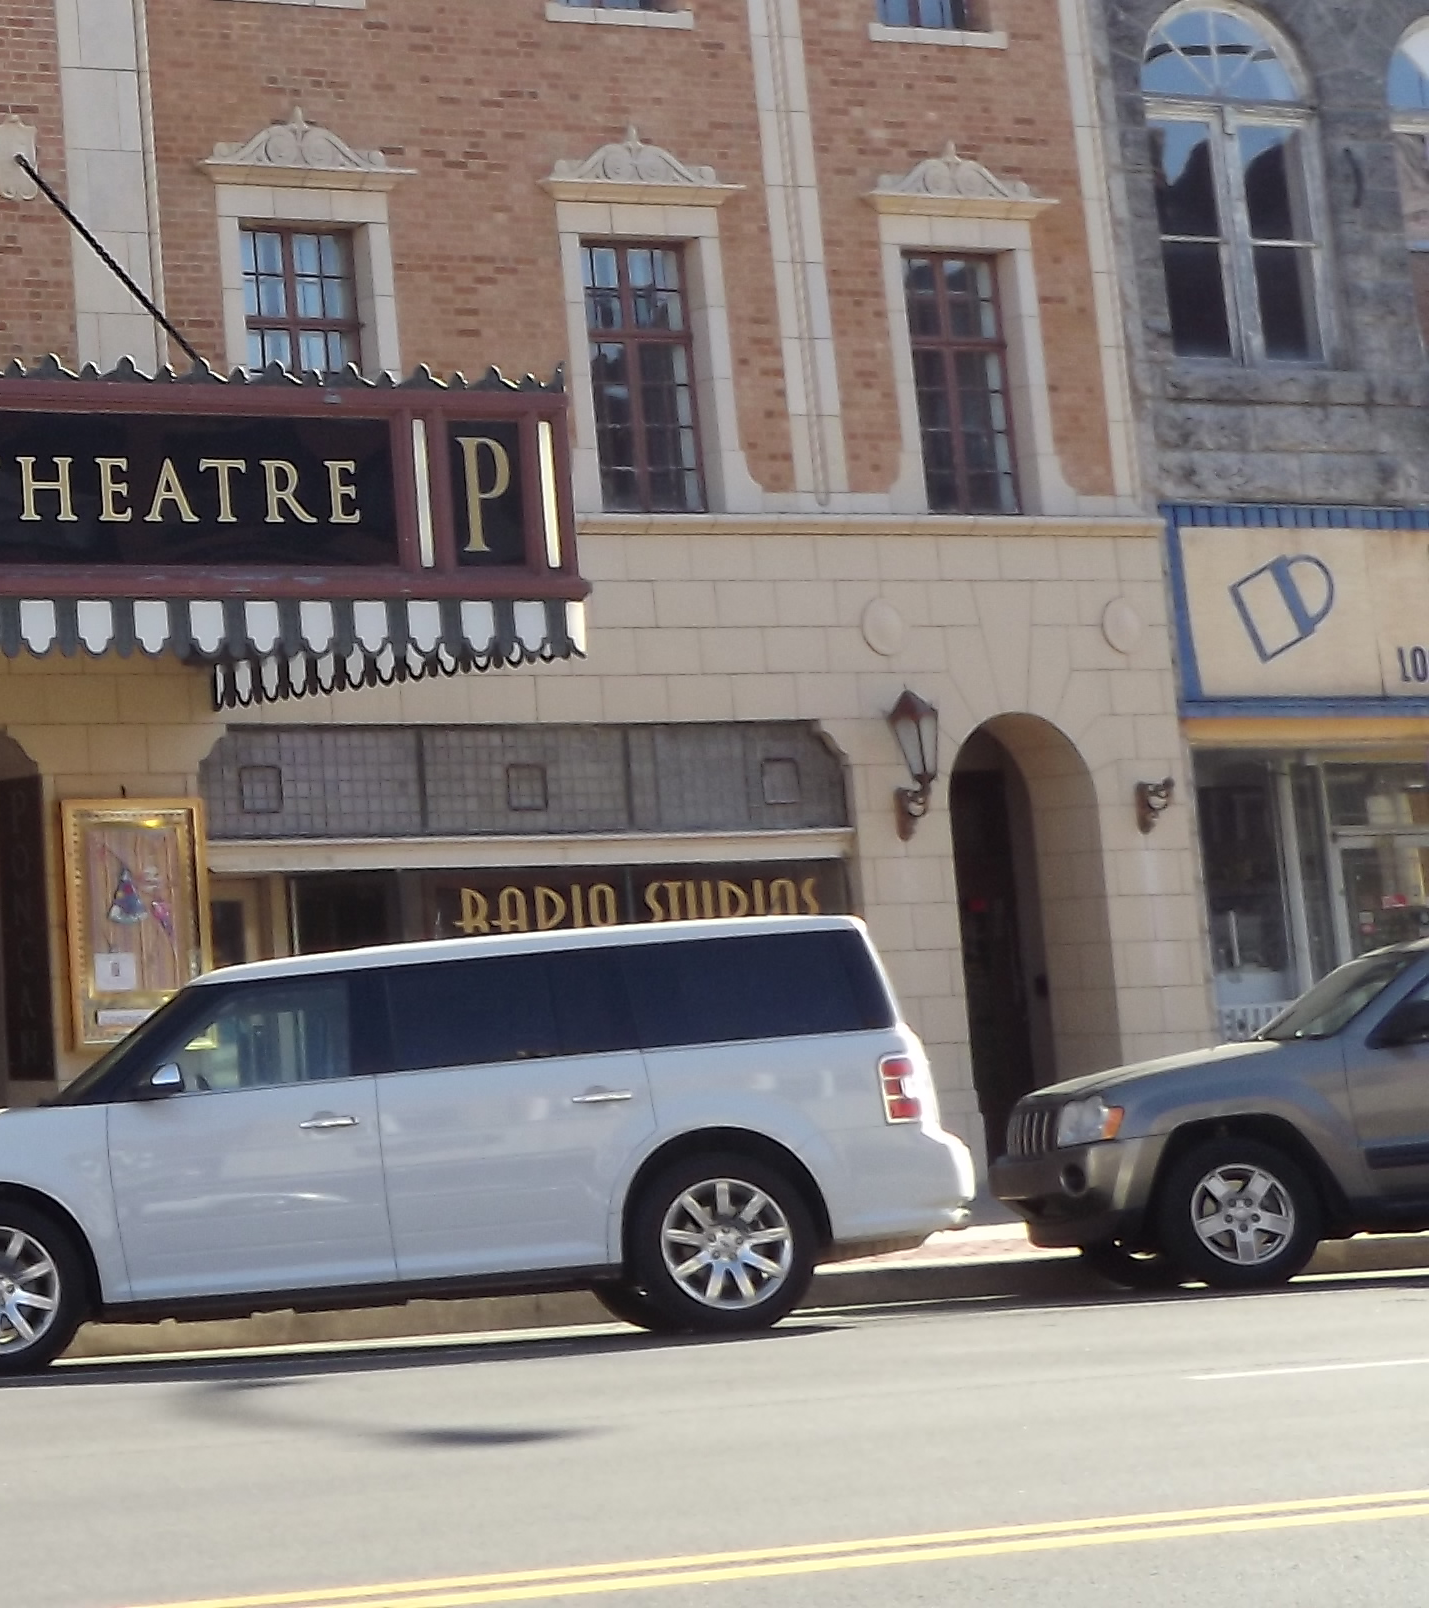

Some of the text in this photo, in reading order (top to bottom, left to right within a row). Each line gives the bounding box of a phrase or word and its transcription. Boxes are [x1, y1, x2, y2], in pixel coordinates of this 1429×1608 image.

[454, 436, 512, 552] P
[453, 877, 821, 934] RADIO STUDIOS
